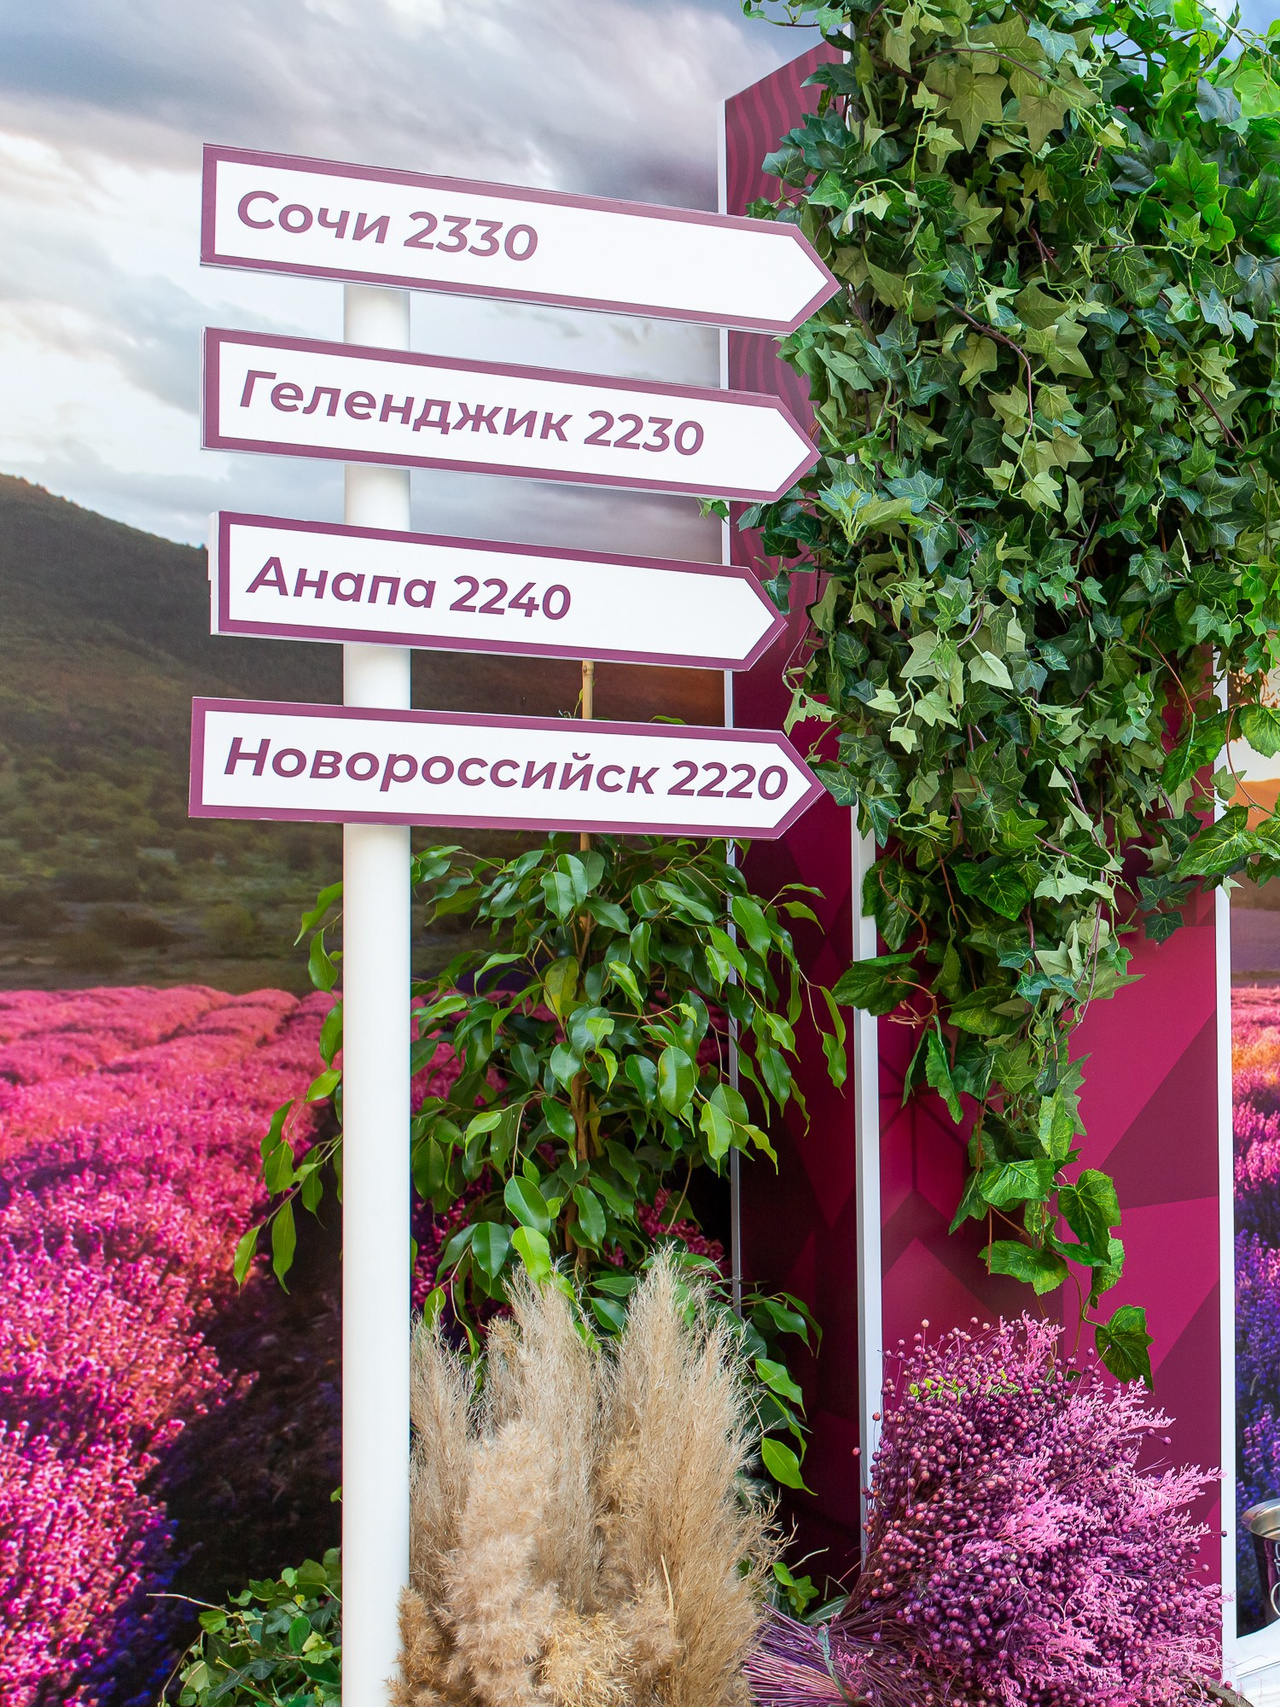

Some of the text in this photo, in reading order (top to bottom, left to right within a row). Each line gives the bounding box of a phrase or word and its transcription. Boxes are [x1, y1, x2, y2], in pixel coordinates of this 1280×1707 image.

[237, 190, 539, 262] Сочи 2330
[239, 369, 705, 456] Геленджик 2230
[245, 556, 572, 621] Анапа 2240
[223, 736, 789, 801] Новороссийск 2220
